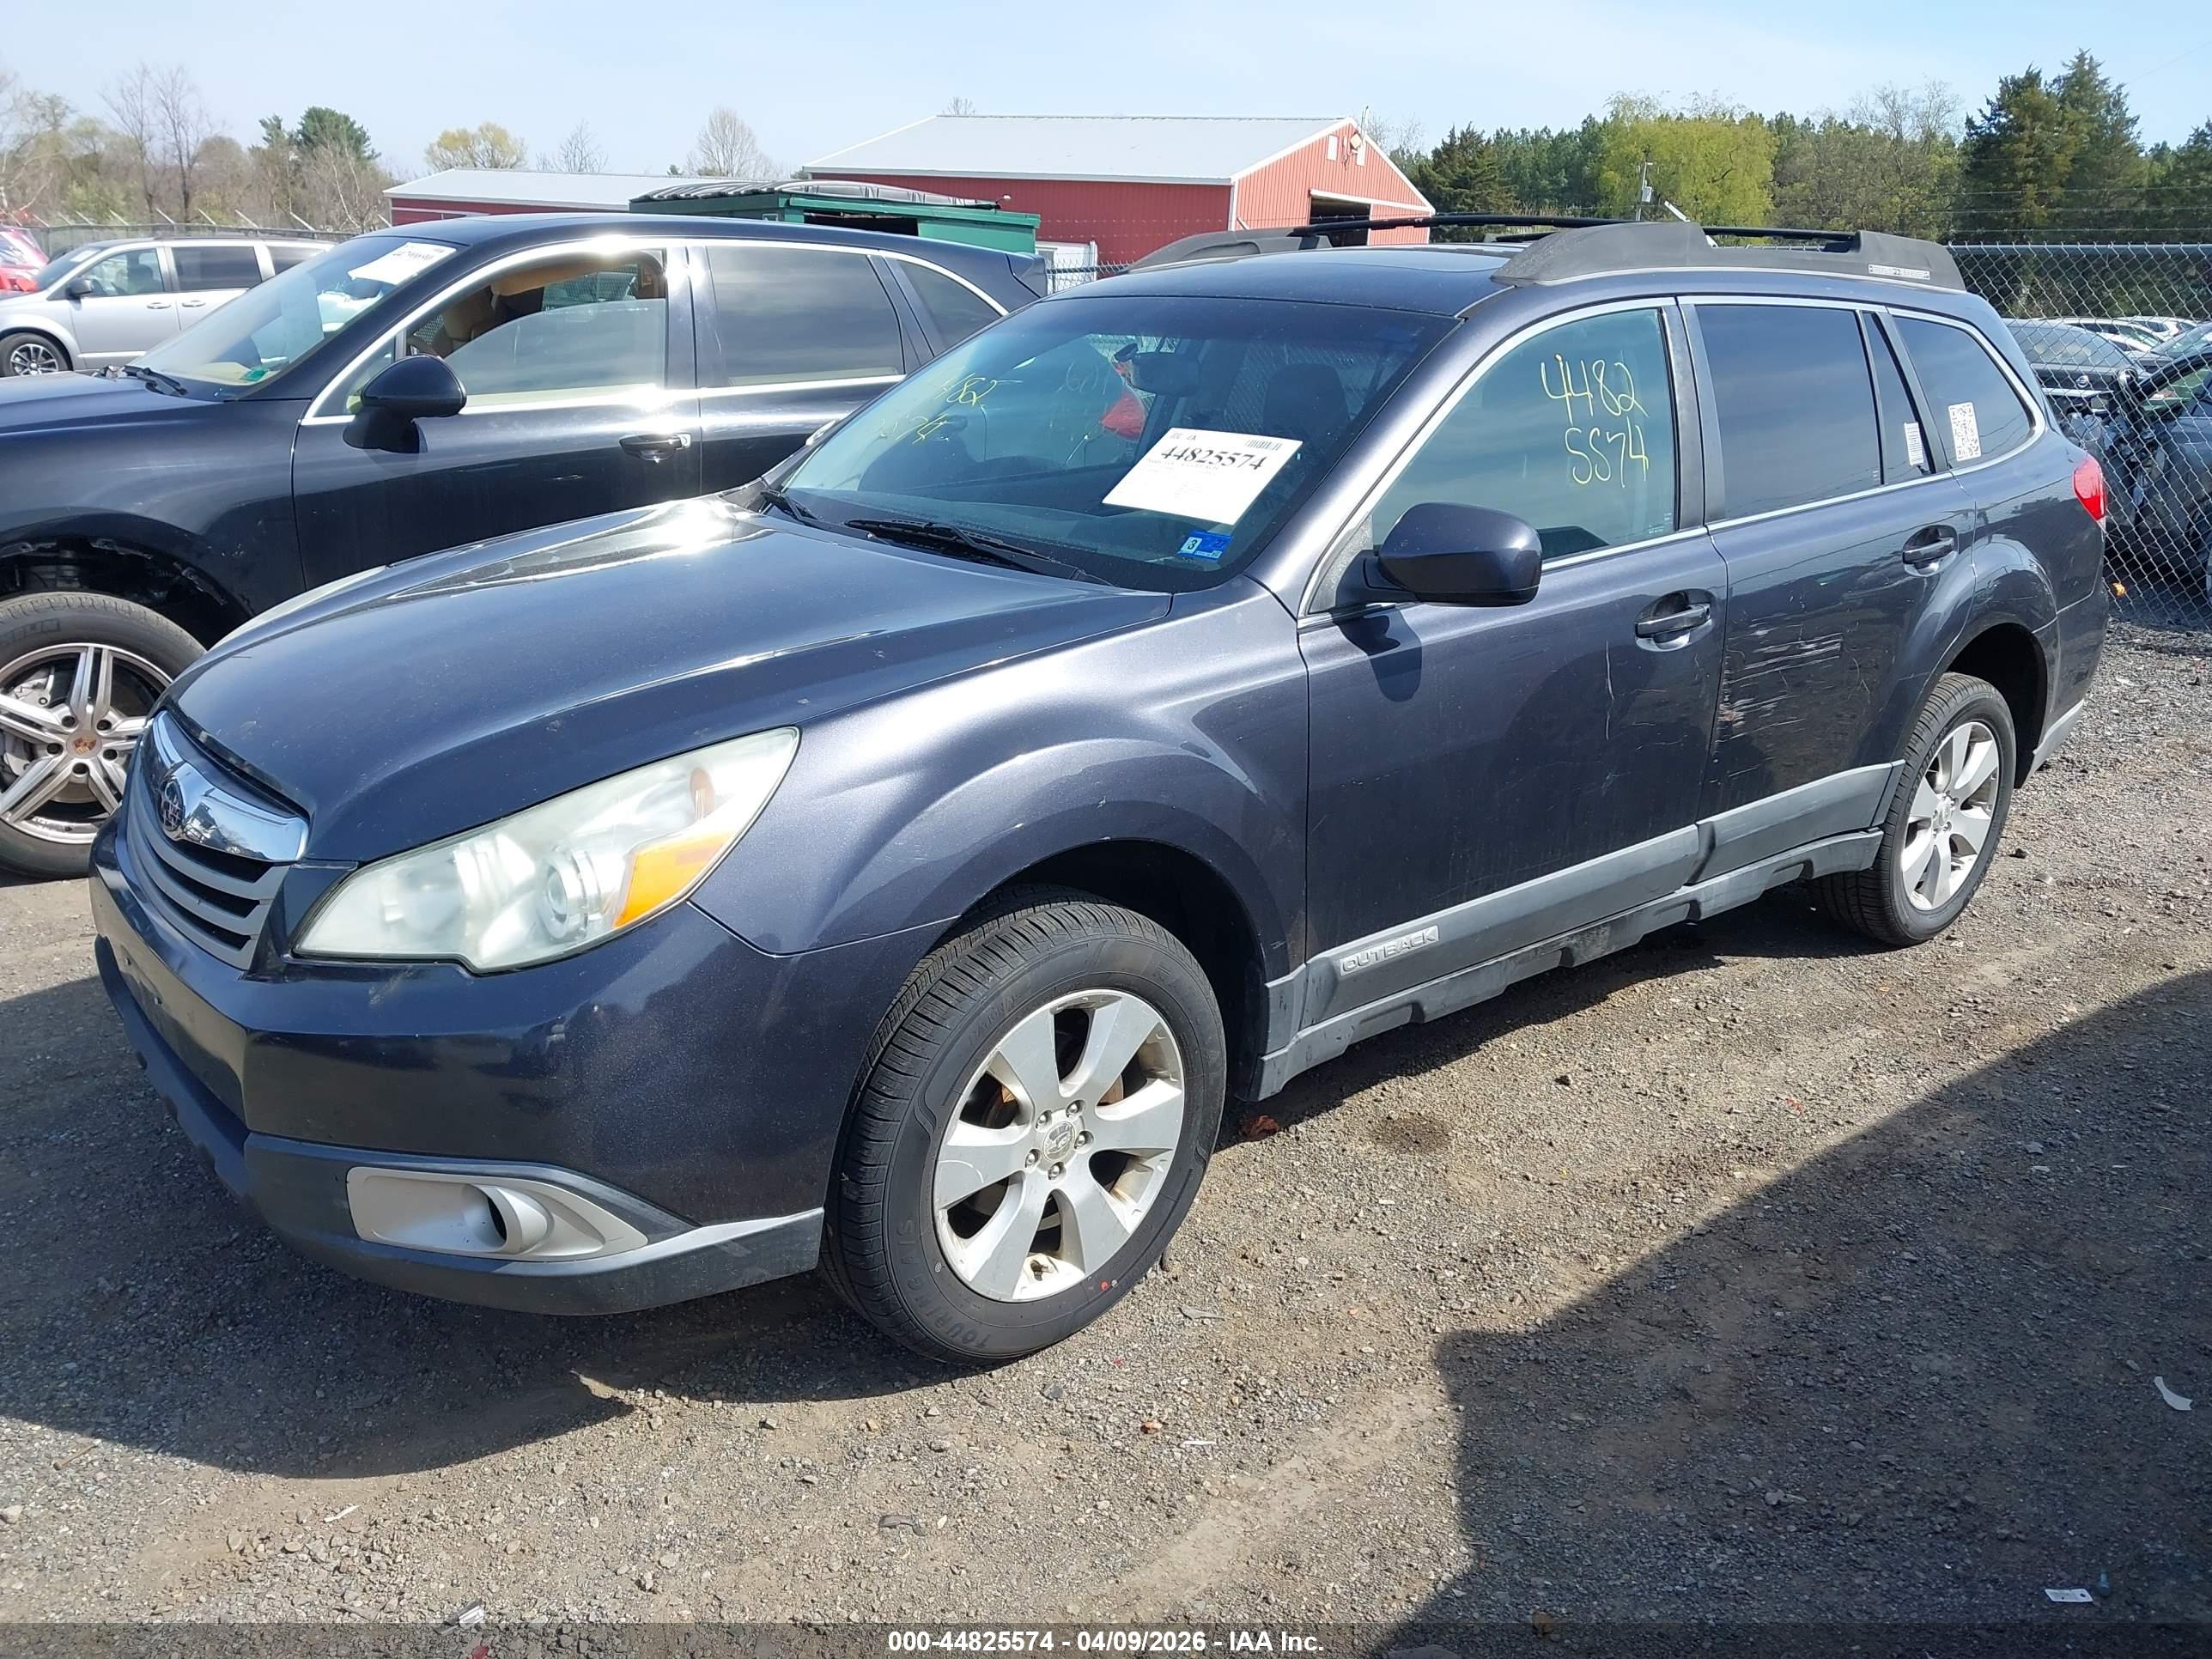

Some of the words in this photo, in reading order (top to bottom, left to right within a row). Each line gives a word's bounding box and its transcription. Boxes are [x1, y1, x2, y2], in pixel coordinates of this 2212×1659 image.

[1540, 354, 1649, 425] 4482
[1161, 446, 1268, 470] 44825574
[1565, 416, 1649, 488] 5574
[1341, 926, 1439, 972] OUTBACK
[907, 1274, 992, 1348] TOURING
